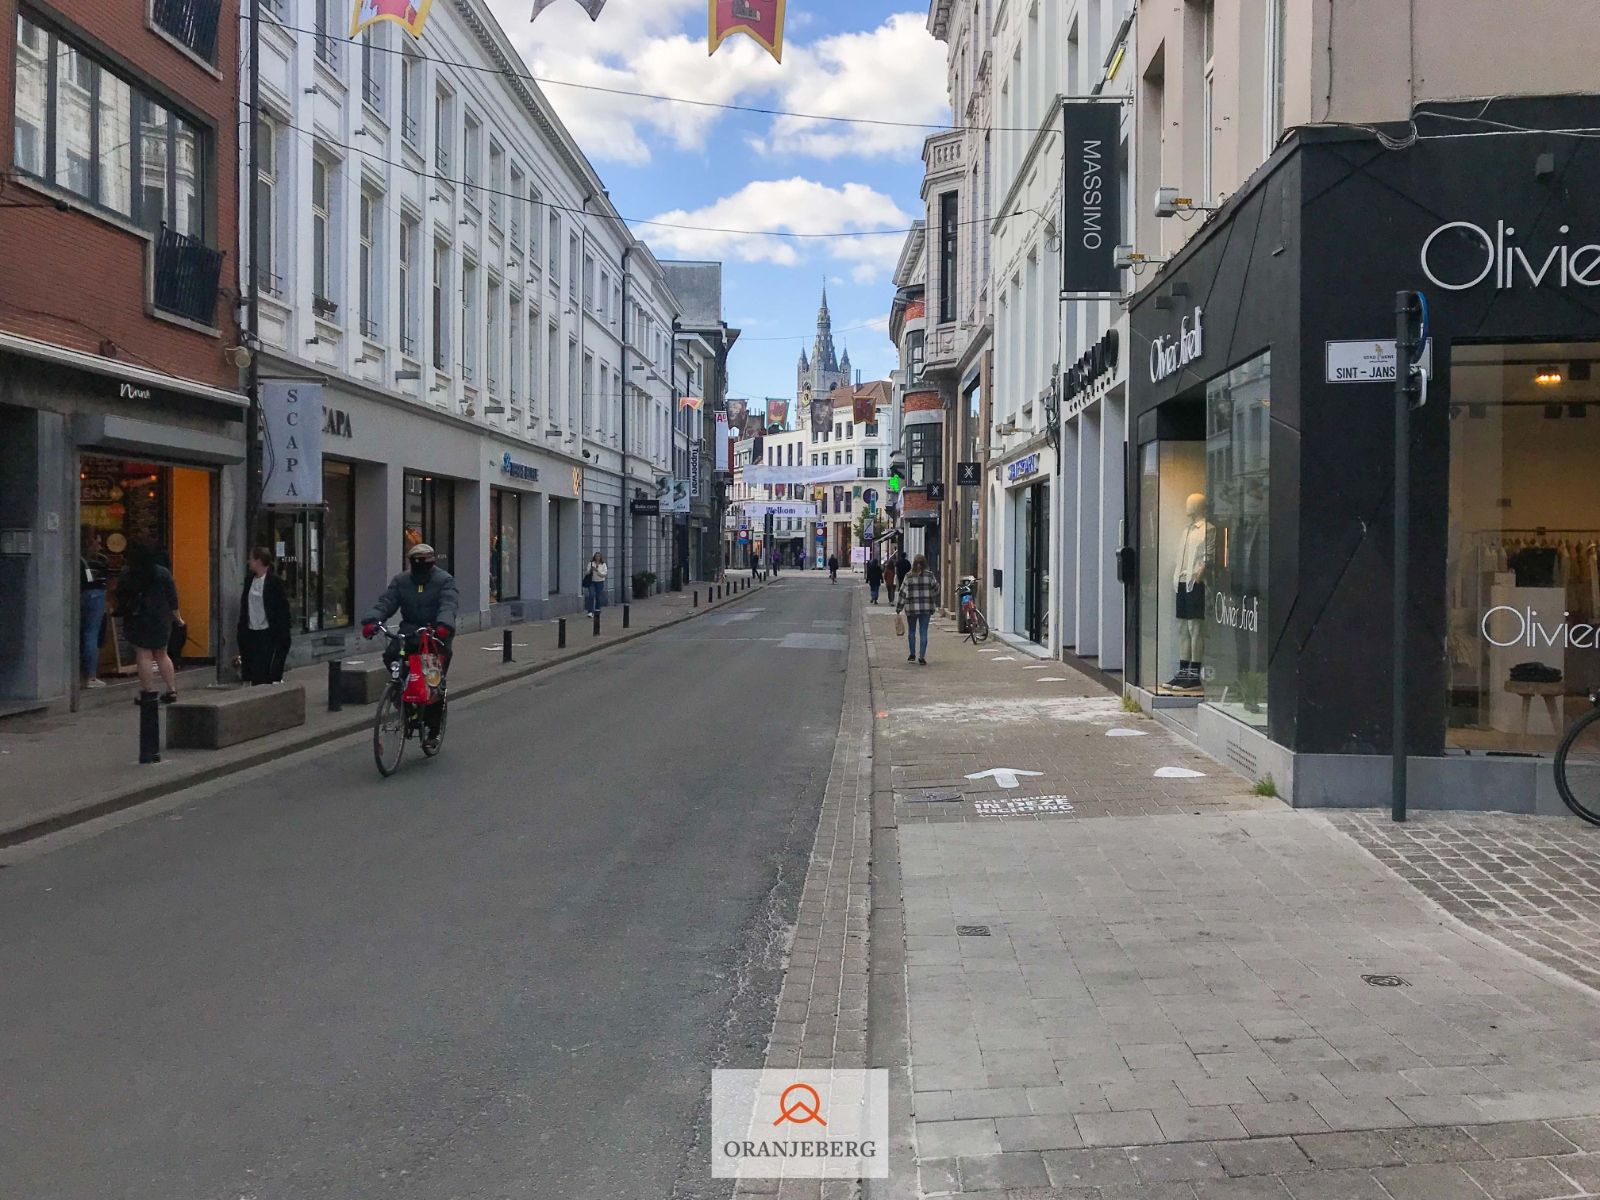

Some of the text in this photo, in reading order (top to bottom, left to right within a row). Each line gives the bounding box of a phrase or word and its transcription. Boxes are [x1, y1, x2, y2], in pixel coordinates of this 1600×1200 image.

[1083, 139, 1102, 250] MASSIMO
[1336, 367, 1358, 379] SINT
[286, 388, 299, 497] SCAPA
[690, 447, 700, 495] Tupperware
[765, 506, 796, 515] Welkom
[1215, 591, 1239, 628] Olivier
